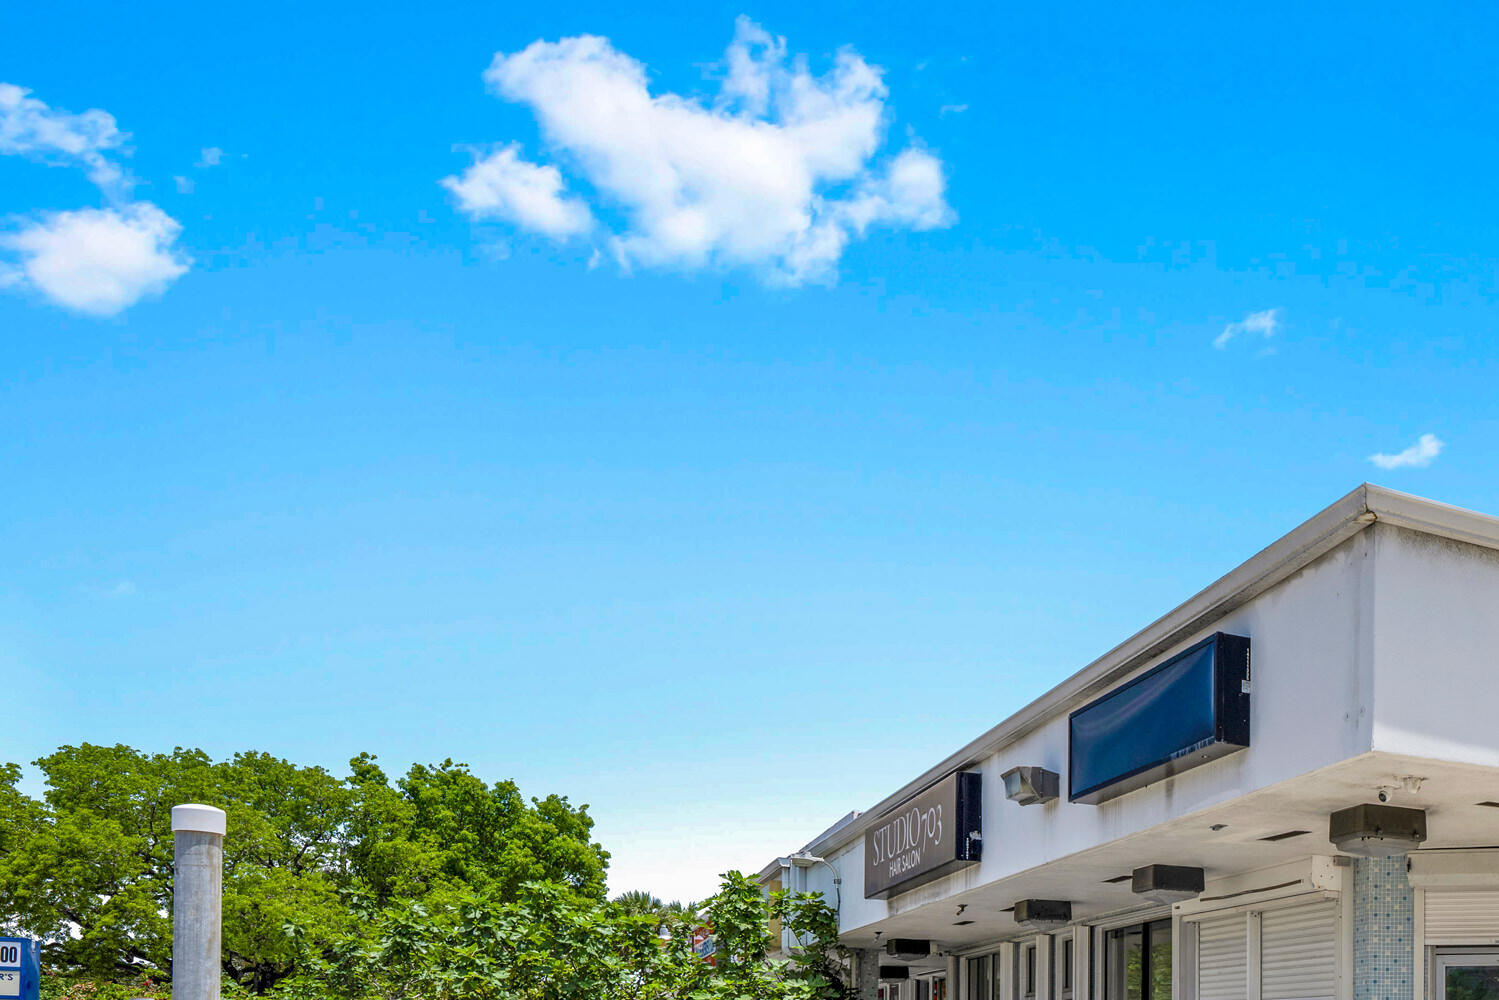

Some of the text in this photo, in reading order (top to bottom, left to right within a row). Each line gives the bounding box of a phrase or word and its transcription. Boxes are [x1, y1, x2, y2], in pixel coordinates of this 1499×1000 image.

[873, 804, 943, 866] STUDIO 703
[889, 848, 921, 878] HAIR SALON
